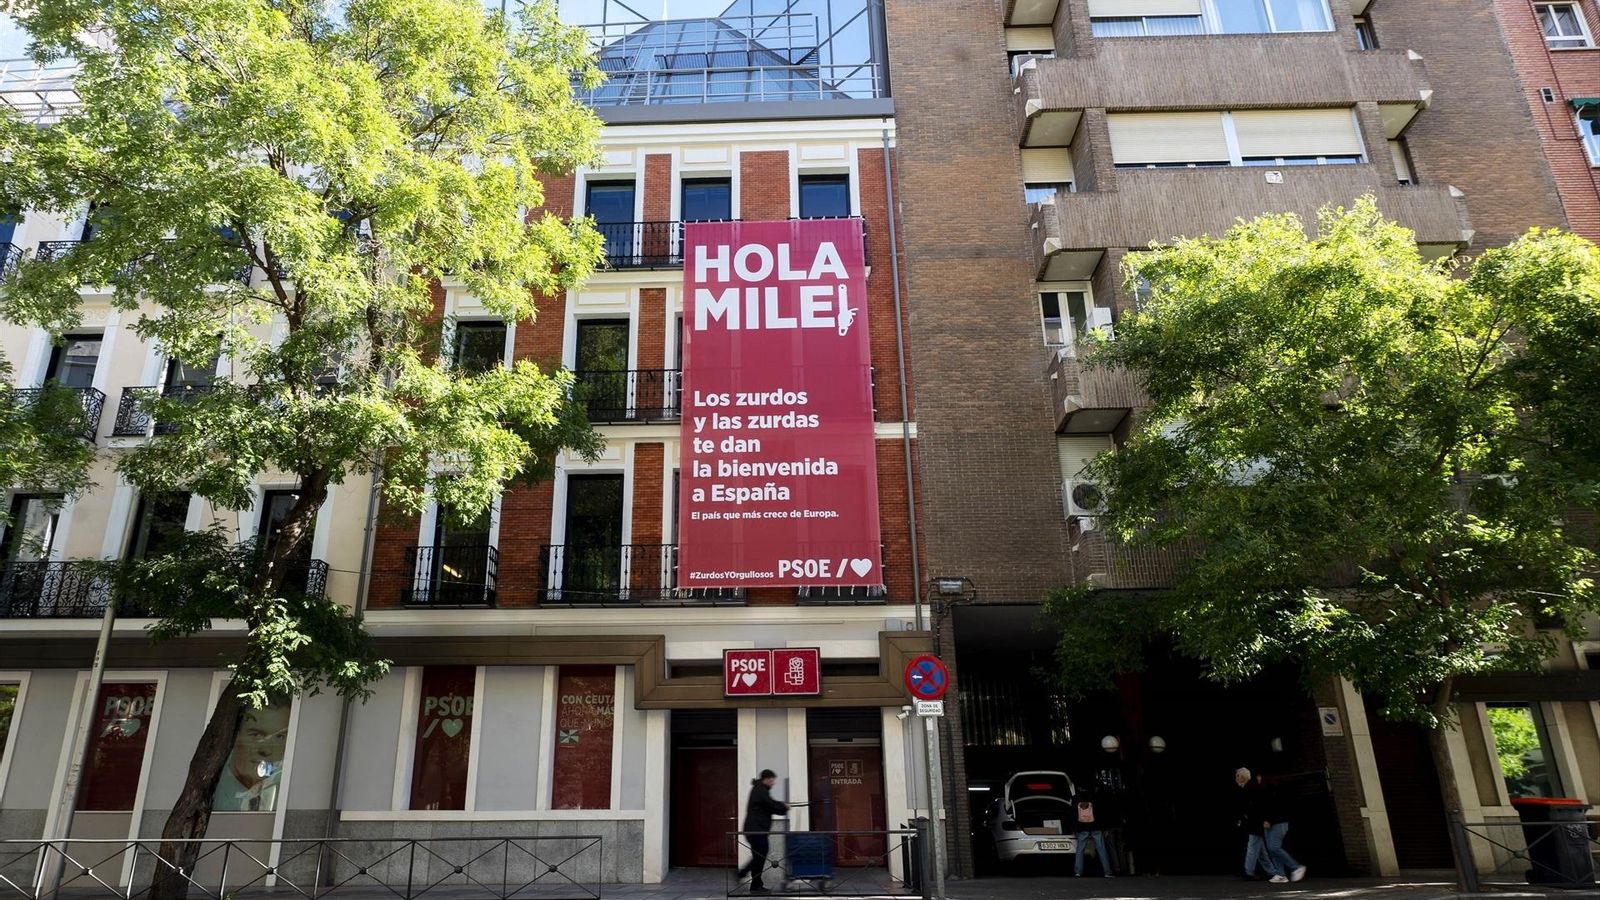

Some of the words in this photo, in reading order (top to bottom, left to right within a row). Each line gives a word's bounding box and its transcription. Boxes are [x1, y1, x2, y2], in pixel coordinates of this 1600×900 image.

[694, 241, 850, 283] HOLA
[694, 390, 731, 407] Los
[735, 388, 808, 406] zurdos
[693, 416, 707, 433] y
[712, 412, 742, 430] las
[747, 411, 820, 429] zurdas
[693, 437, 715, 453] te
[720, 435, 761, 453] dan
[692, 459, 712, 478] la
[718, 457, 839, 477] bienvenida
[692, 487, 705, 502] a
[711, 482, 790, 505] España
[691, 511, 700, 520] El
[702, 510, 721, 521] país
[723, 512, 741, 521] que
[742, 510, 762, 519] más
[789, 510, 802, 518] de
[803, 510, 839, 519] Europa.
[689, 571, 774, 580] #ZurdosYOrgullosos
[778, 559, 831, 578] PSOE
[731, 658, 766, 672] PSOE
[561, 695, 582, 704] CON
